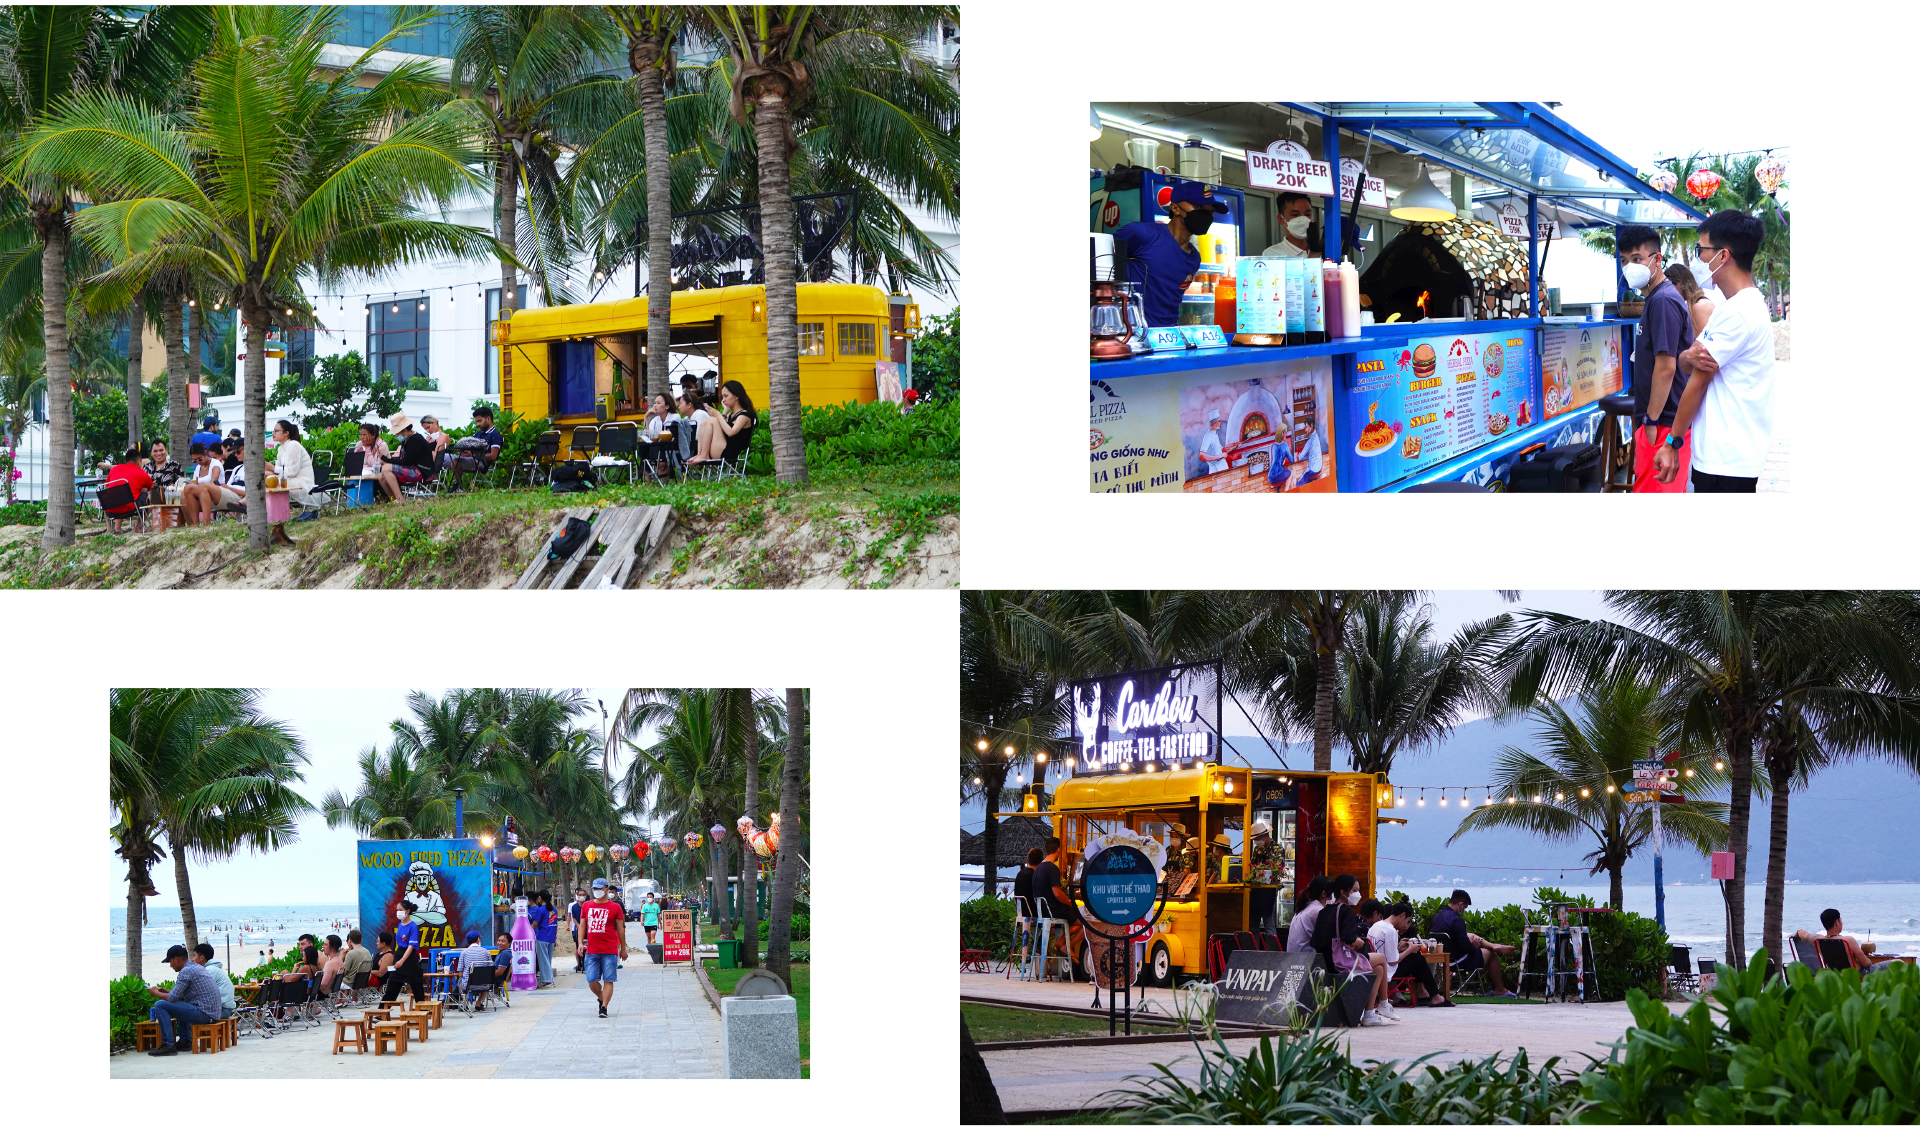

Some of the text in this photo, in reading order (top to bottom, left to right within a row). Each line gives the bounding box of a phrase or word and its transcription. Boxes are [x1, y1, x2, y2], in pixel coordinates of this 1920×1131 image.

[1253, 155, 1292, 173] DRAFT
[1296, 162, 1328, 178] BEER
[1276, 173, 1308, 188] 20K
[1503, 216, 1523, 227] PIZZA
[1158, 332, 1179, 344] A09
[1201, 330, 1221, 342] A16
[1506, 337, 1524, 348] DRINK
[1357, 359, 1385, 374] PASTA
[1409, 377, 1443, 393] BURGER
[1456, 371, 1477, 384] PIZZA
[1099, 401, 1127, 417] PIZZA
[1104, 415, 1123, 423] PIZZA
[1410, 412, 1438, 429] SNACK
[1110, 443, 1145, 459] GIỐNG
[1147, 448, 1170, 459] NHƯ
[1093, 459, 1139, 484] TA BIẾT
[1126, 480, 1146, 493] THU
[1150, 471, 1179, 487] MÌNH
[1117, 680, 1194, 734] Caribou
[1265, 787, 1284, 802] pepsi
[359, 851, 404, 868] WOOD
[447, 849, 487, 867] PIZZA
[1092, 881, 1151, 895] KHU VỰC THỂ THAO
[1107, 896, 1137, 904] SPORTS AREA
[669, 932, 686, 940] PIZZA
[512, 940, 533, 952] CHILL
[1225, 968, 1282, 992] VNPAY
